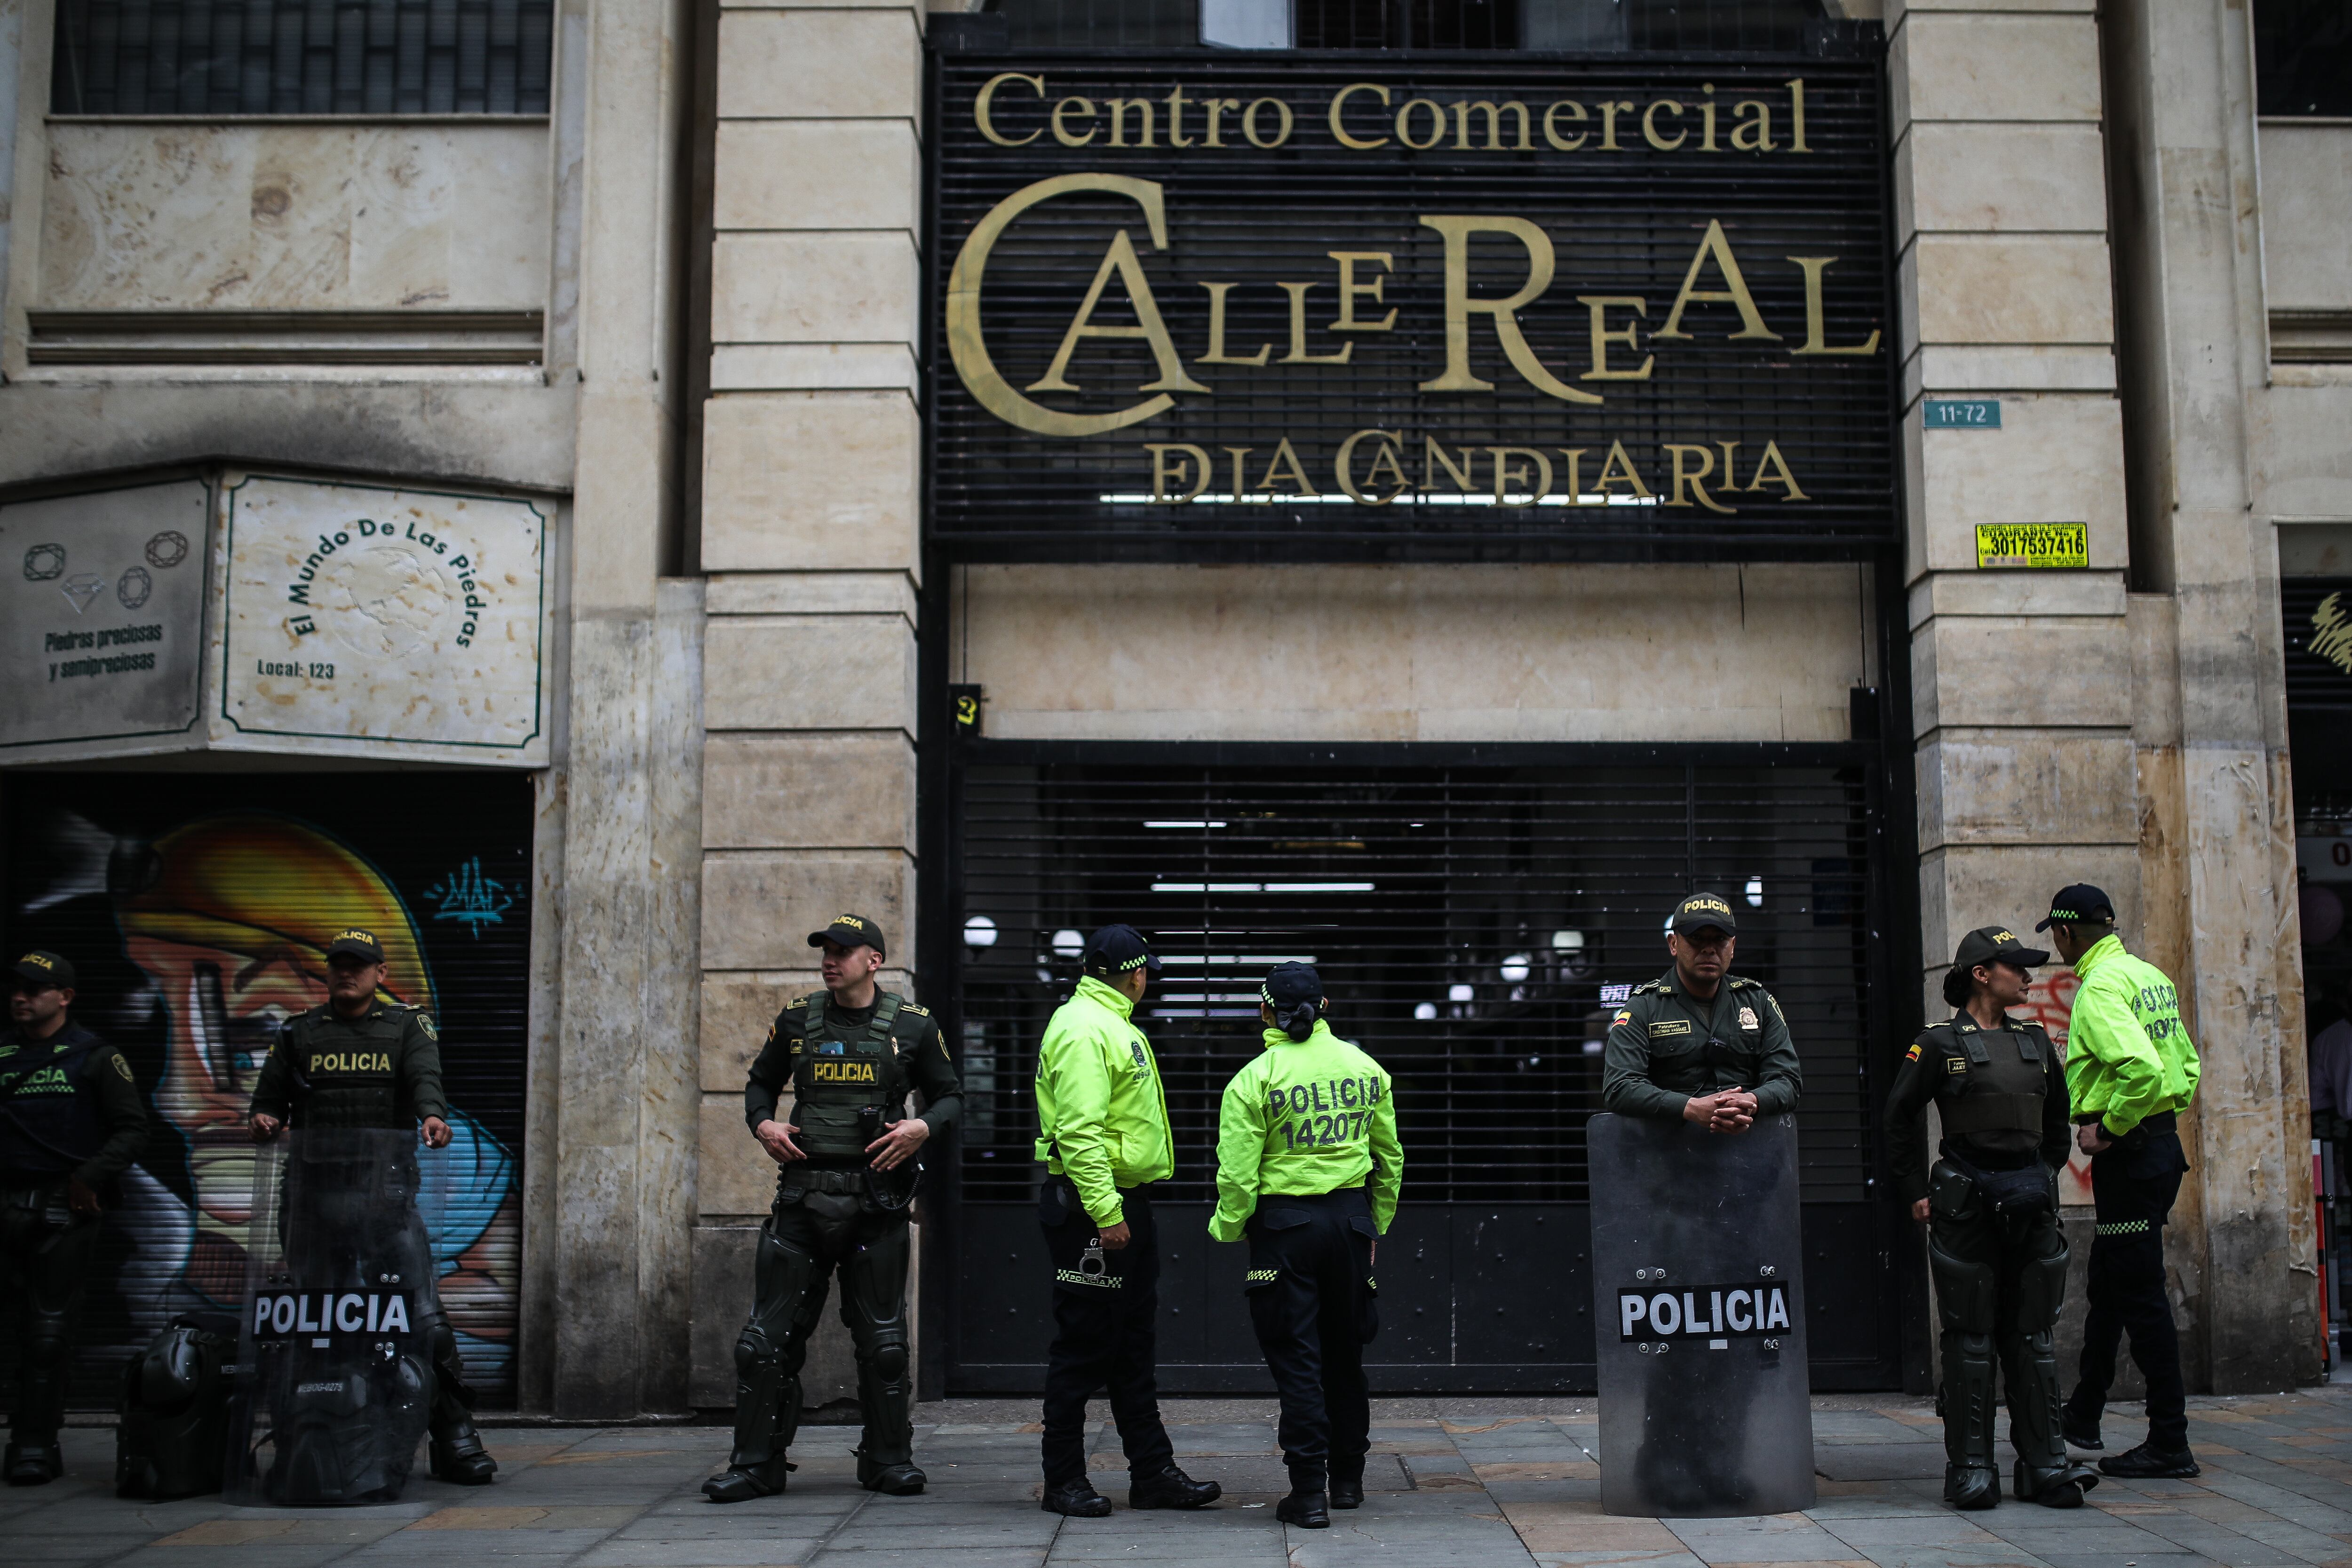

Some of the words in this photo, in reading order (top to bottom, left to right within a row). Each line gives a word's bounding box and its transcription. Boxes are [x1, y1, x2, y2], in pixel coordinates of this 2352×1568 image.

[974, 72, 1294, 149] Centro
[1328, 77, 1813, 154] Comercial
[1417, 215, 1882, 405] REAL
[1938, 404, 1987, 423] 11-72
[357, 518, 395, 537] De
[405, 521, 448, 555] Las
[1991, 537, 2085, 556] 3017537416
[287, 530, 350, 606] Mundo
[448, 553, 487, 649] Piedras
[289, 613, 316, 637] El
[257, 659, 304, 677] Local:
[309, 661, 335, 680] 123
[1684, 898, 1731, 915] POLICIA
[310, 1052, 391, 1072] POLICIA
[814, 1063, 875, 1082] POLICIA
[1269, 1076, 1380, 1118] POLICIA
[1070, 1274, 1106, 1285] POLICIA
[253, 1293, 410, 1335] POLICIA
[1621, 1288, 1790, 1336] POLICIA
